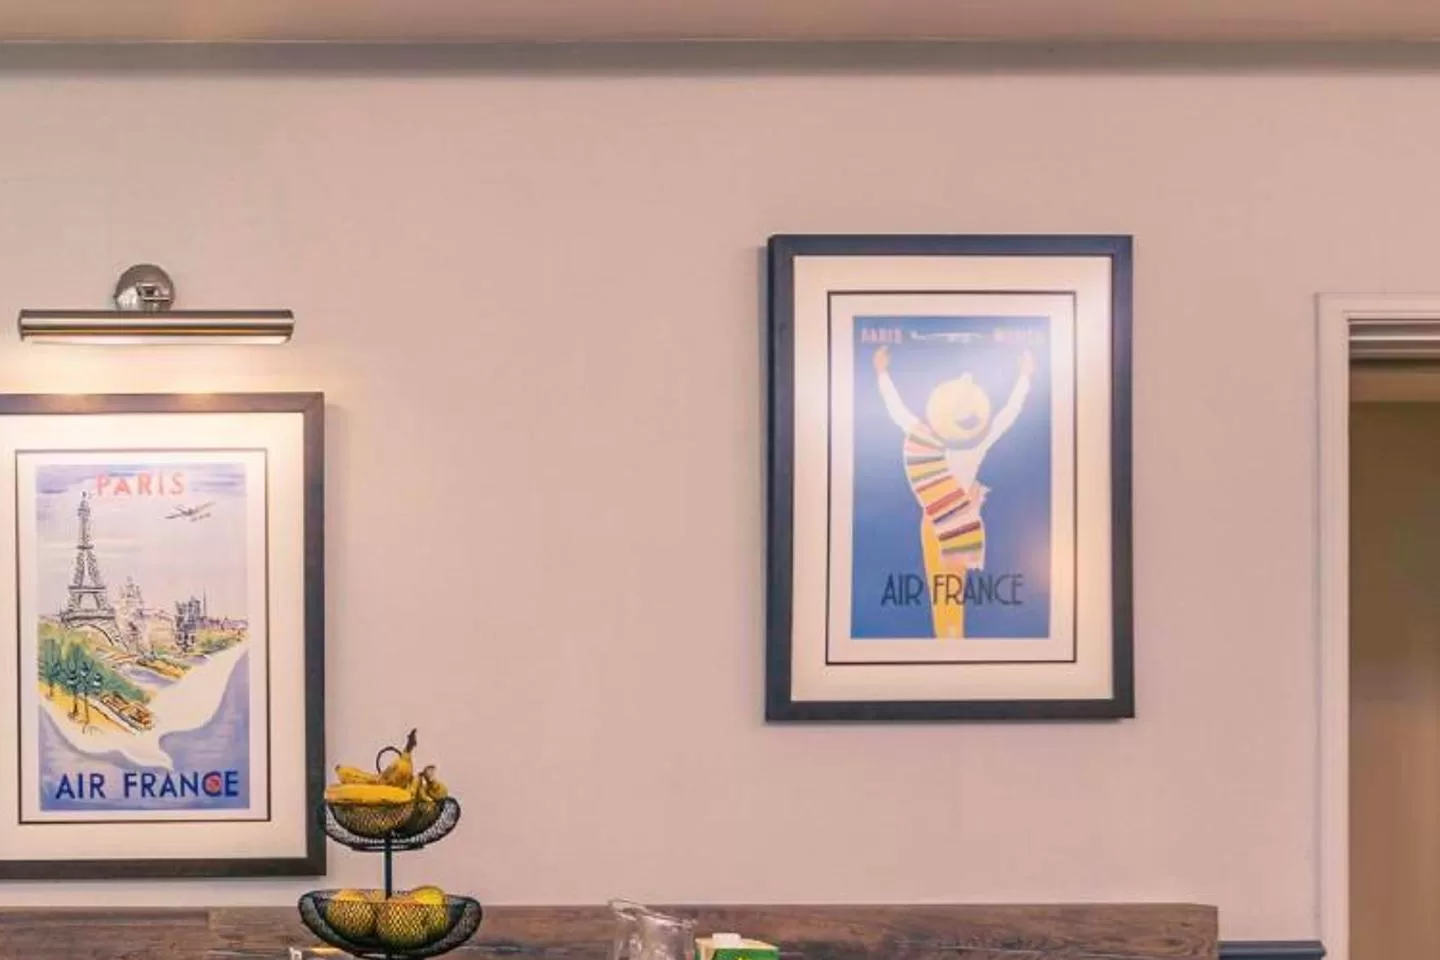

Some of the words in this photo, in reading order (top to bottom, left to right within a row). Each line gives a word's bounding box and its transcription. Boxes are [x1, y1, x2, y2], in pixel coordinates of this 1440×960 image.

[96, 471, 185, 496] PARIS
[880, 572, 925, 606] AIR
[932, 573, 1024, 606] FRANCE
[55, 773, 106, 799] AIR
[123, 771, 240, 799] FRANCE
